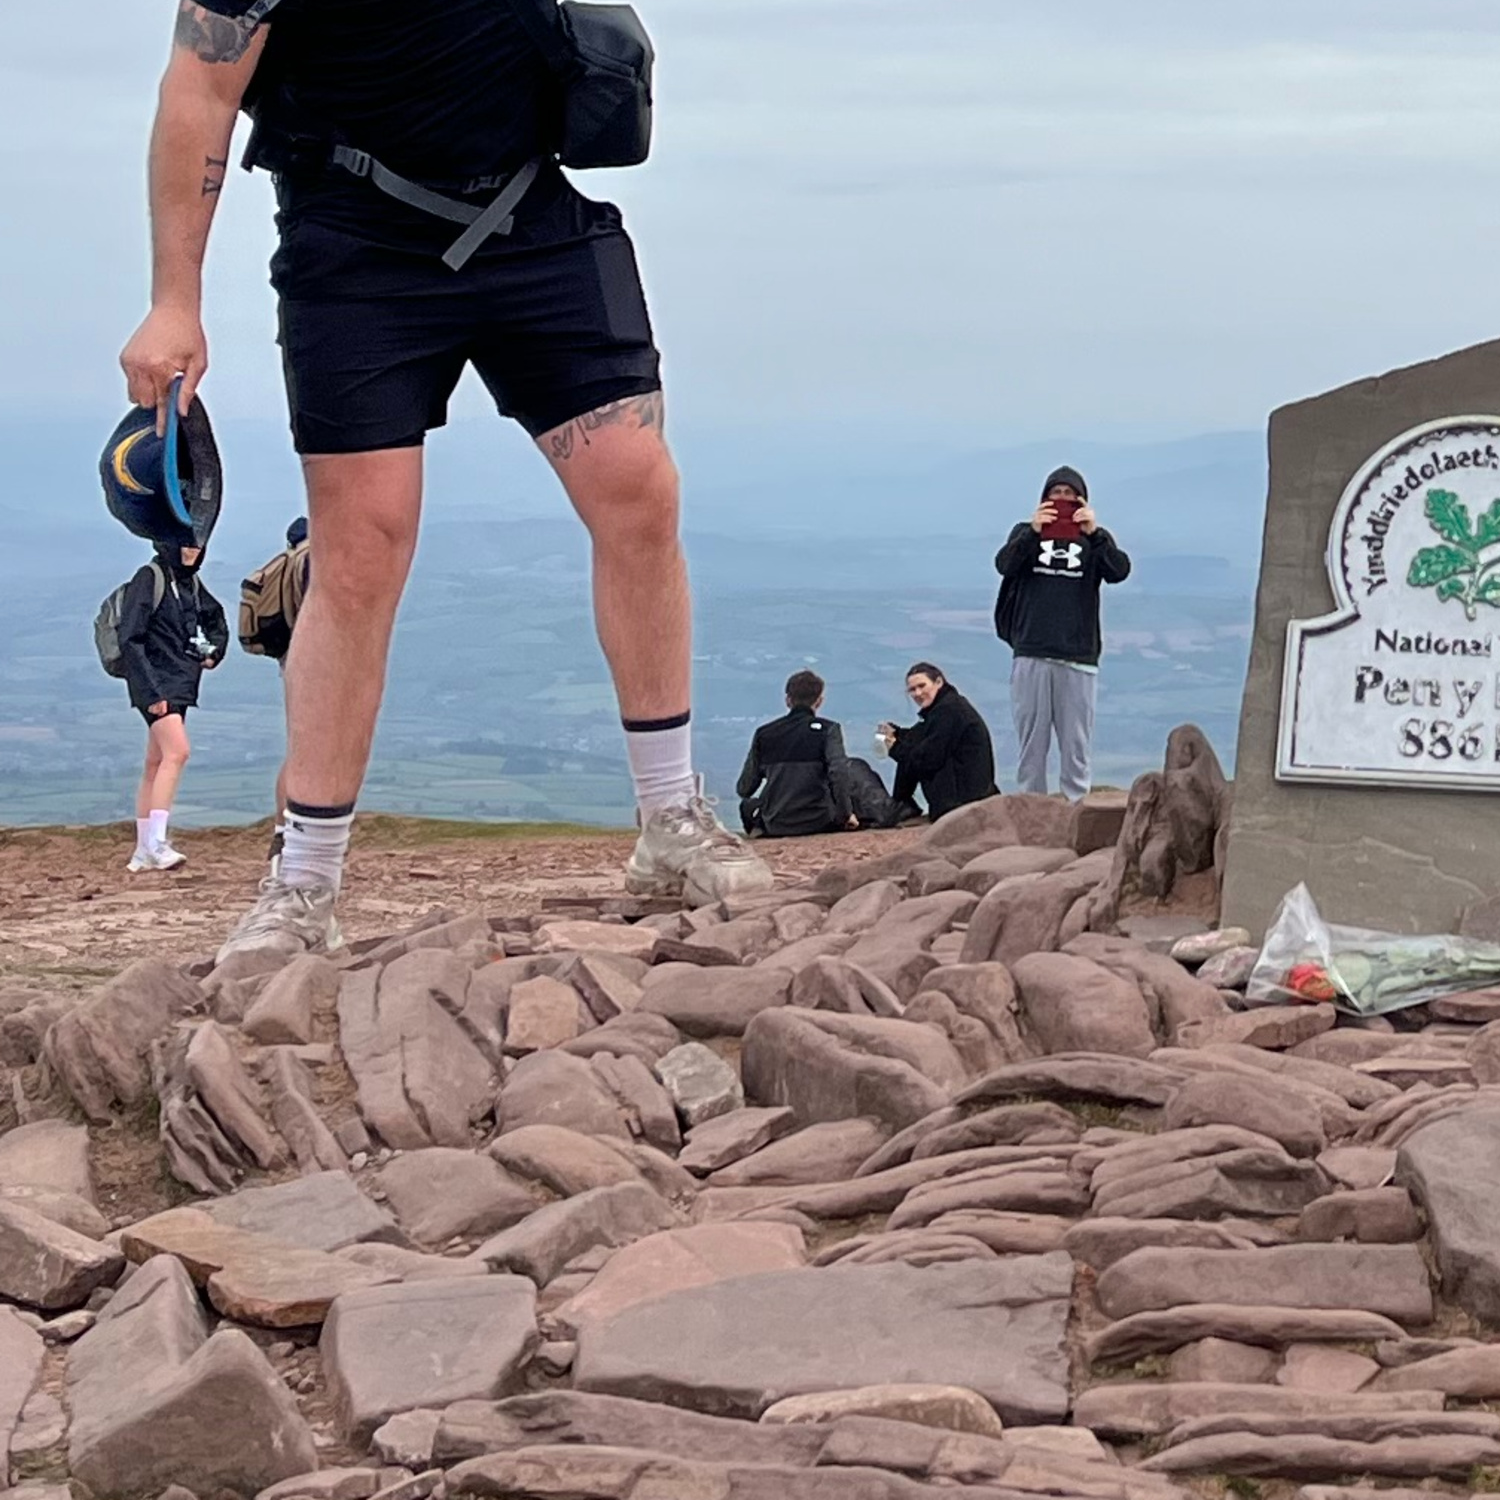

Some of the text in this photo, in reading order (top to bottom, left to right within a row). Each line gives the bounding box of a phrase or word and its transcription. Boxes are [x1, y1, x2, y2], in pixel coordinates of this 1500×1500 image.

[1374, 628, 1492, 658] National
[1354, 665, 1442, 708] Pen
[1453, 680, 1483, 719] y
[1399, 717, 1484, 760] 886
